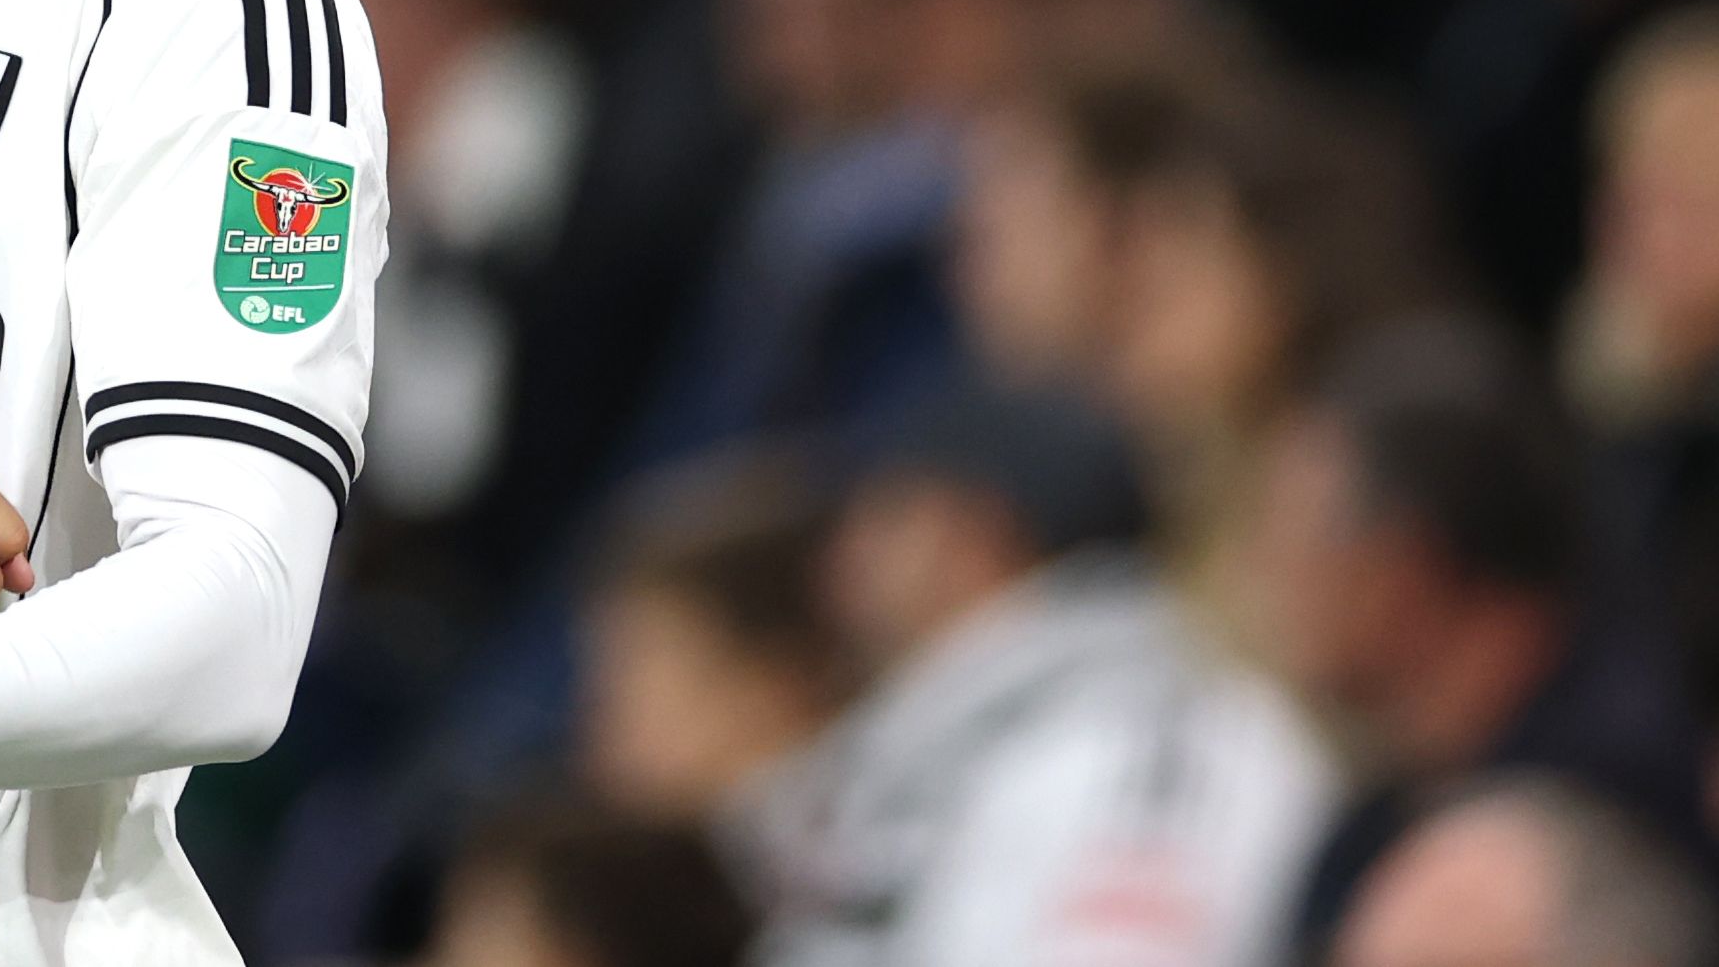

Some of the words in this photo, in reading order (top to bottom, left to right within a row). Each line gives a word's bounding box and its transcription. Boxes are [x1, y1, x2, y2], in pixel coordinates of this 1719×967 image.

[223, 229, 341, 254] Carabao
[249, 256, 306, 283] Cup
[272, 304, 306, 323] EFL
